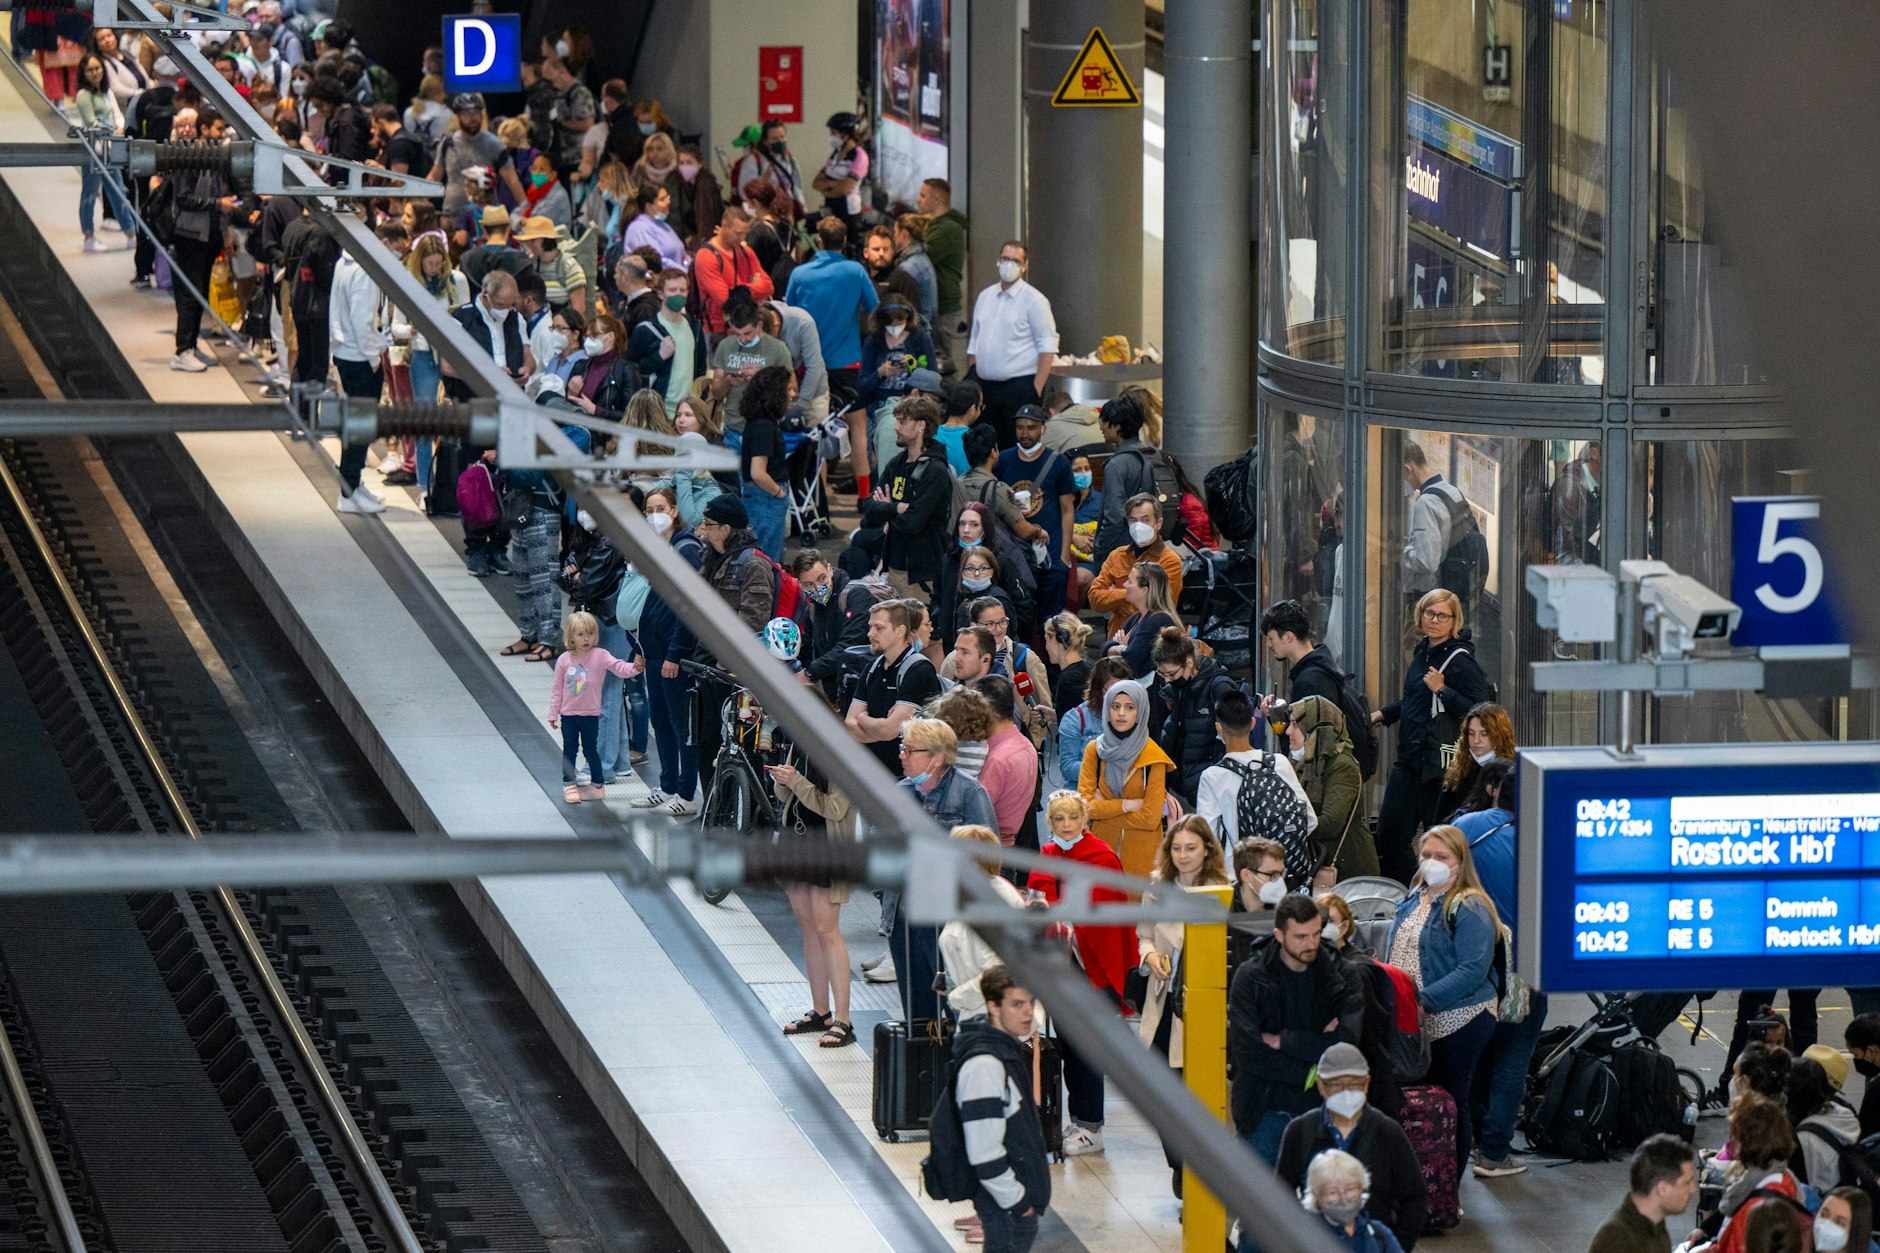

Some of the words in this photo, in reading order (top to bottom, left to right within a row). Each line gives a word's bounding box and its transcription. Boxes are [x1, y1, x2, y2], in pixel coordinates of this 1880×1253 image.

[454, 18, 496, 76] D
[1486, 48, 1507, 81] H
[1754, 502, 1824, 614] 5
[1576, 821, 1594, 837] RE
[1762, 817, 1841, 834] Neustrelitz
[1671, 837, 1780, 866] Rostock
[1790, 834, 1836, 863] Hbf
[1668, 900, 1693, 920] RE
[1699, 899, 1713, 919] 5
[1766, 897, 1838, 918] Demmin
[1576, 931, 1628, 952] 10:42
[1668, 928, 1693, 949] RE
[1699, 928, 1713, 948] 5
[1766, 926, 1842, 947] Rostock
[1849, 924, 1880, 945] Hbf
